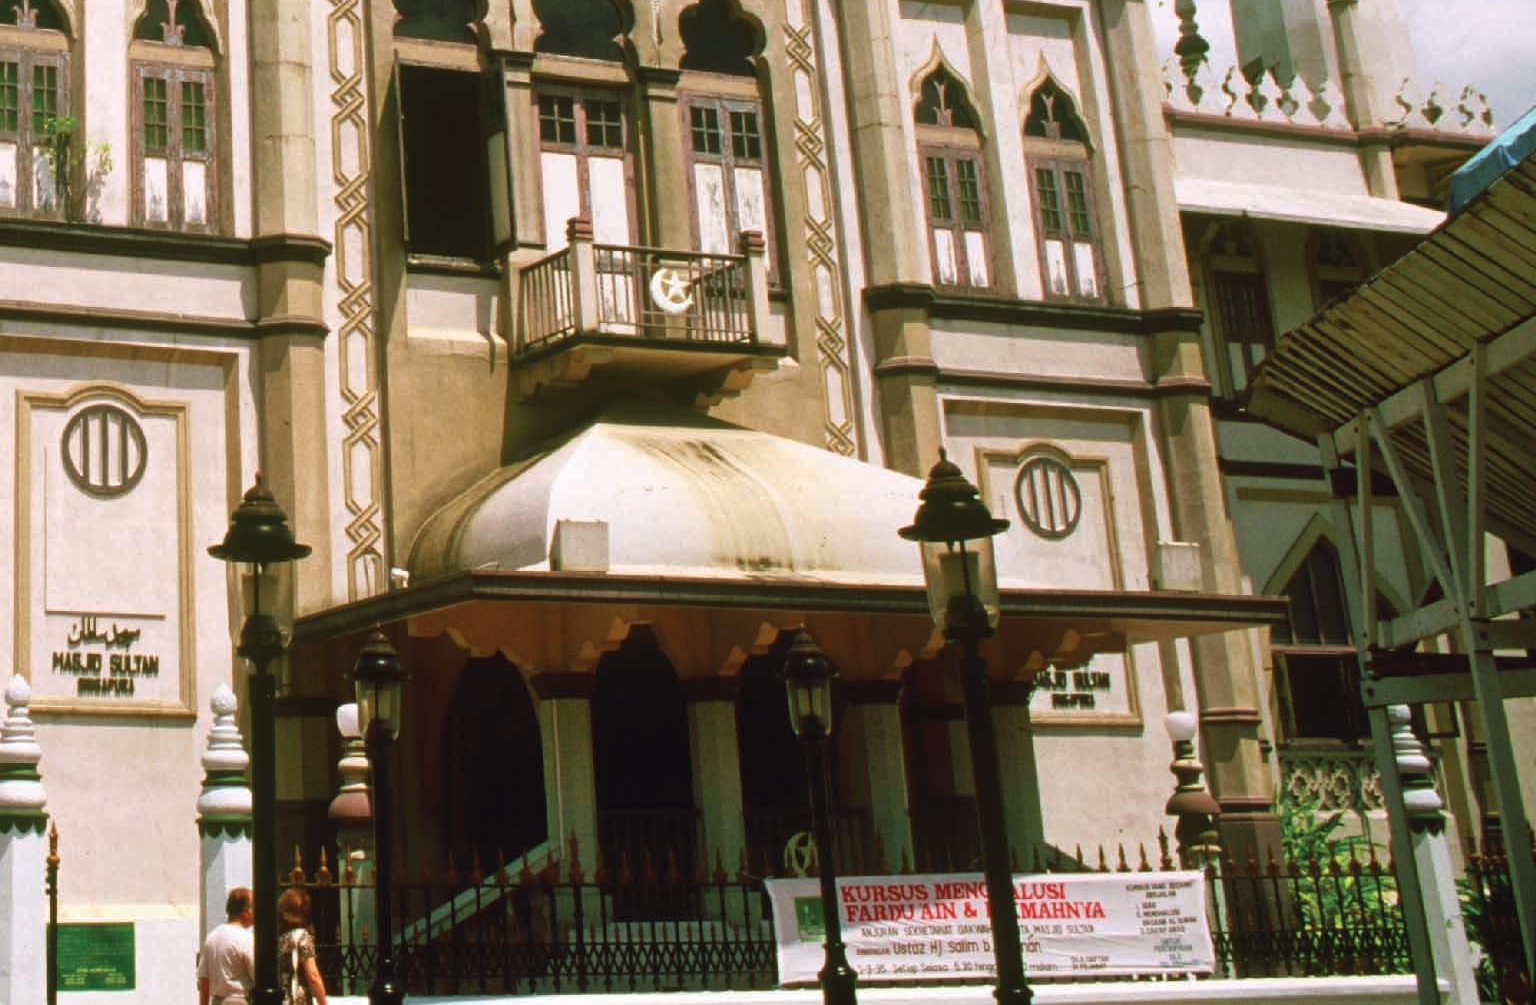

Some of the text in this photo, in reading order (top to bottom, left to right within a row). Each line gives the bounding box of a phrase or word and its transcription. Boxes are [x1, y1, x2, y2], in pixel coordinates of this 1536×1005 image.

[52, 652, 160, 677] MASJID SULTAN
[840, 884, 928, 903] KURSUS
[846, 903, 915, 922] FARDU
[920, 902, 957, 919] AIN
[964, 901, 978, 918] &
[892, 941, 925, 955] Ustaz
